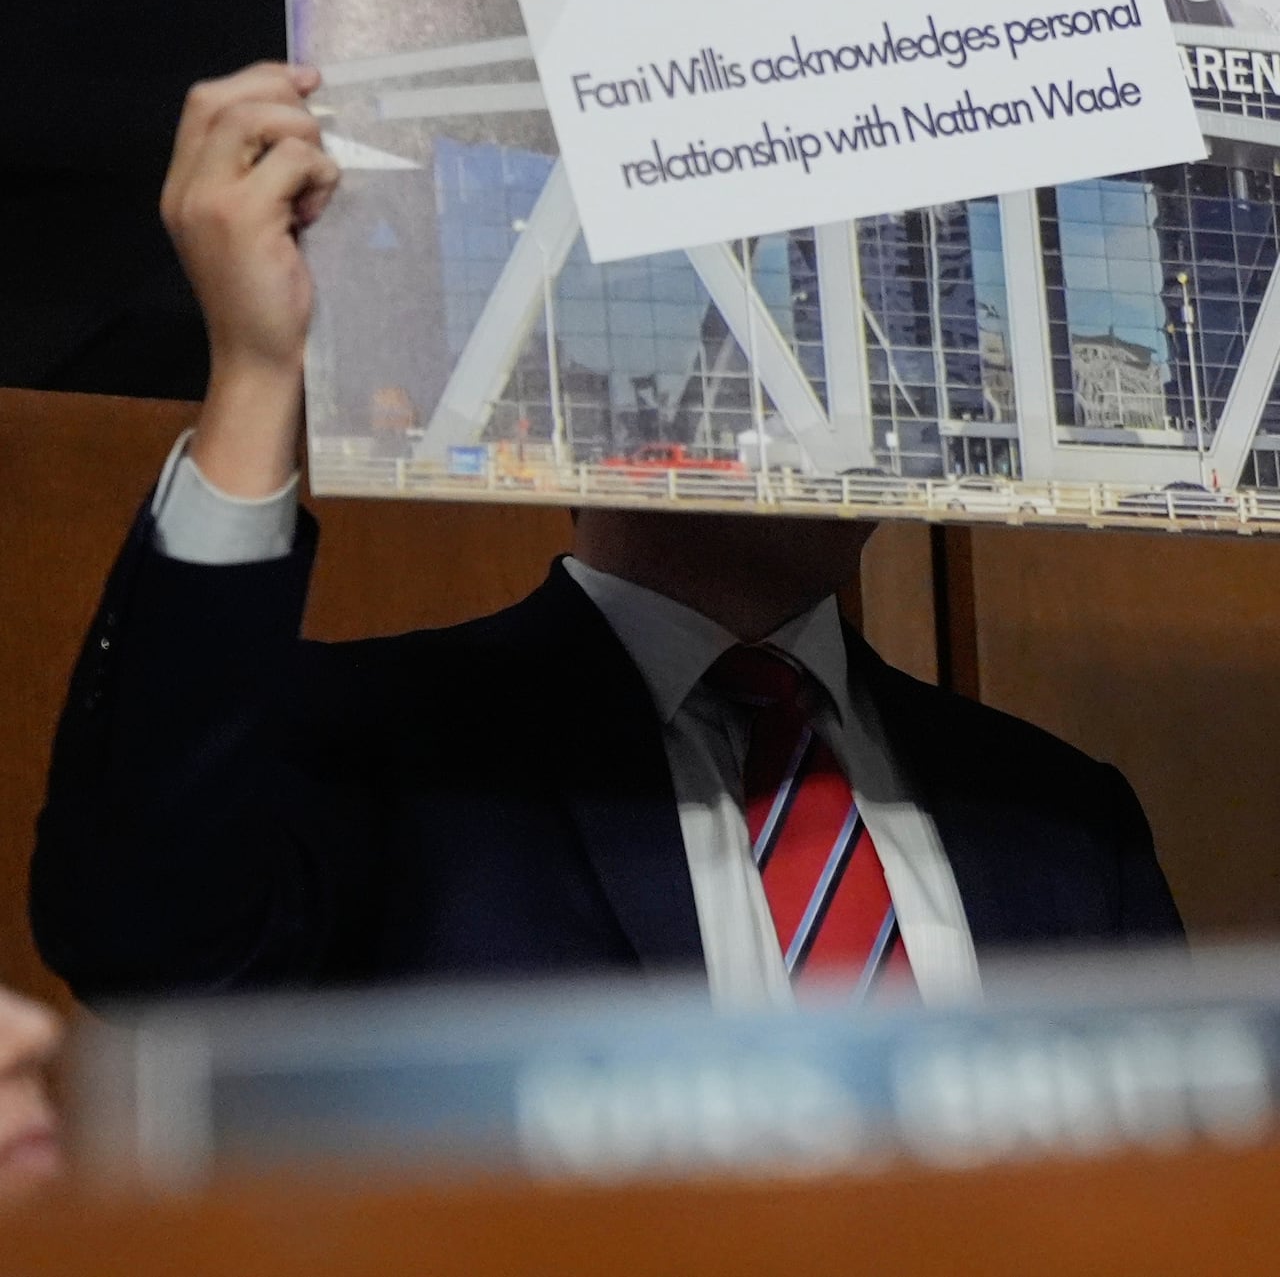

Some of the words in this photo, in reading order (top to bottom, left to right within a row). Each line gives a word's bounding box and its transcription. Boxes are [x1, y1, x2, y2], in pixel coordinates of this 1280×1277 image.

[572, 62, 651, 111] Fani
[649, 46, 747, 98] Willis
[750, 13, 1001, 84] acknowledges
[621, 120, 822, 188] relationship
[824, 103, 901, 154] with
[900, 88, 1034, 142] Nathan
[1030, 66, 1142, 119] Wade
